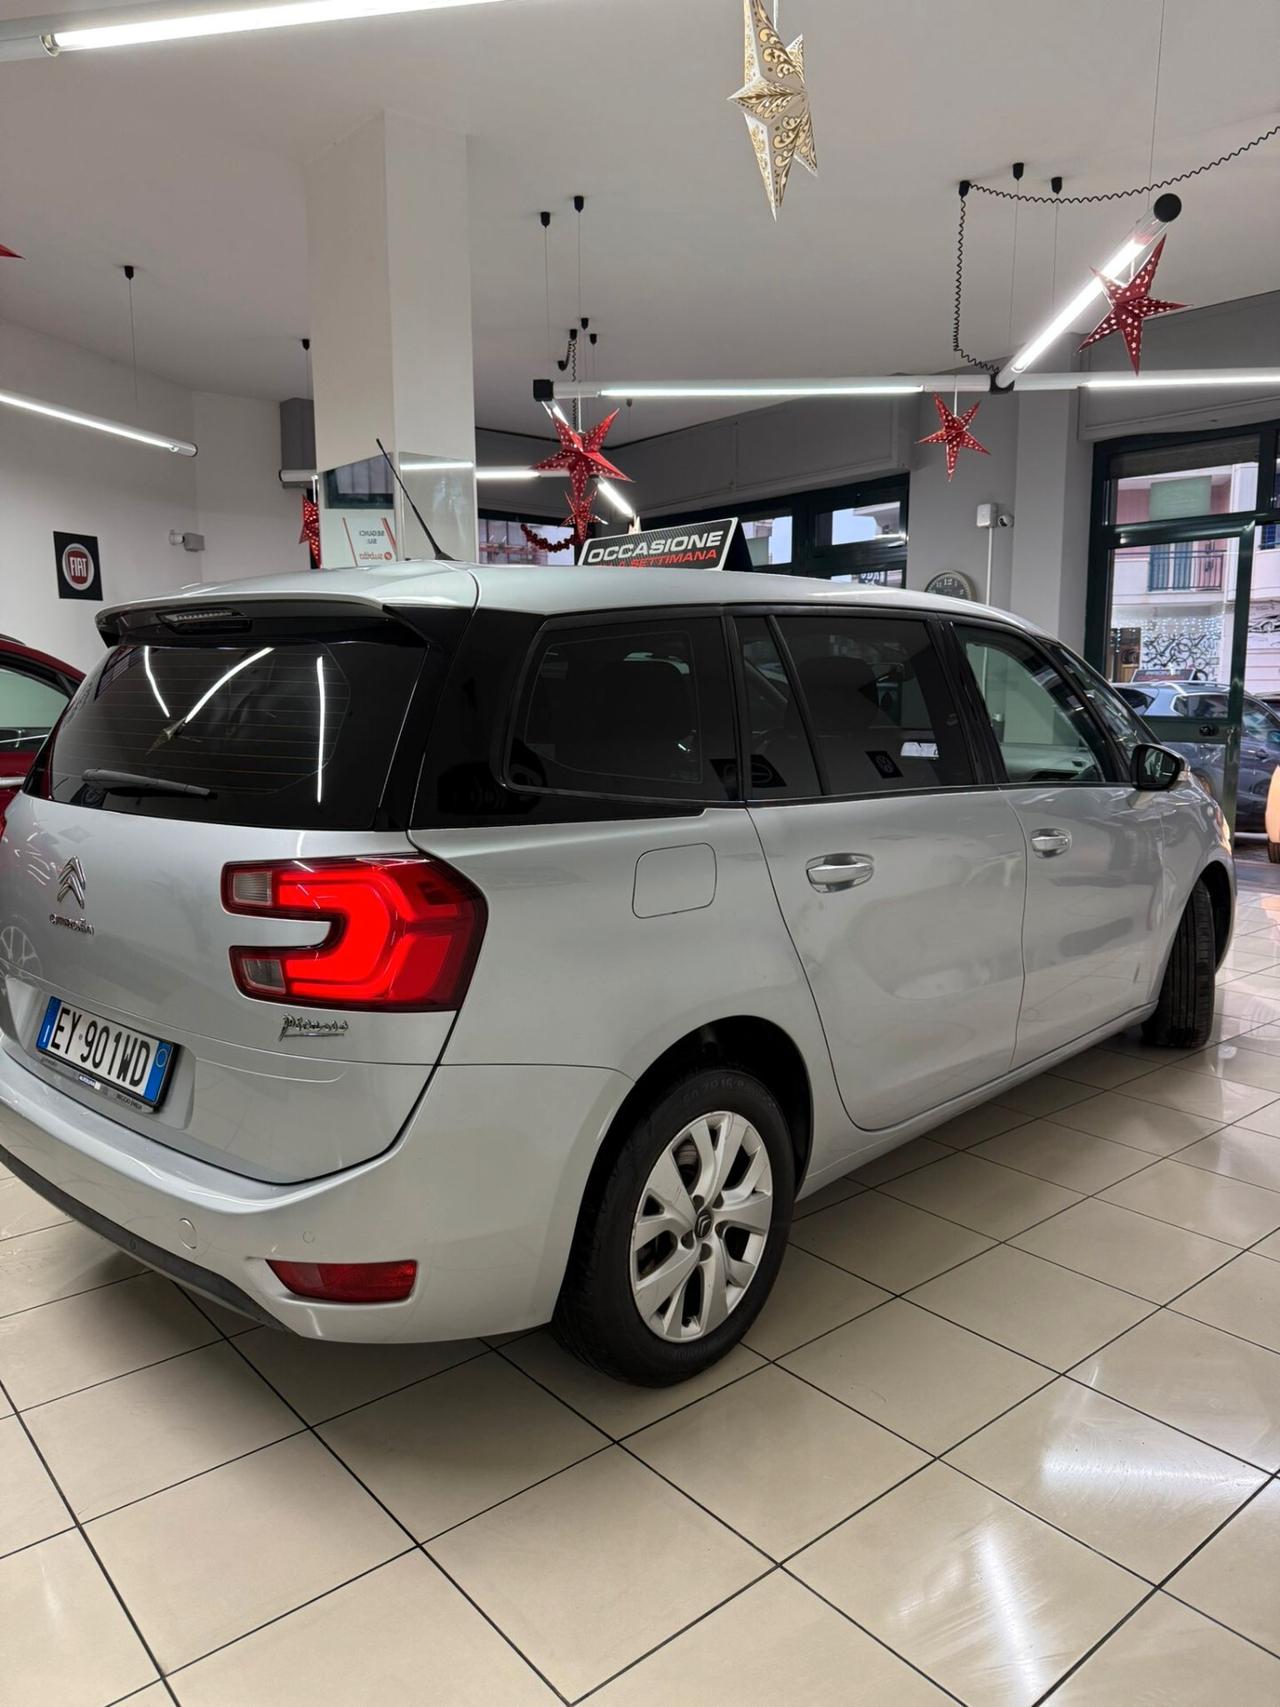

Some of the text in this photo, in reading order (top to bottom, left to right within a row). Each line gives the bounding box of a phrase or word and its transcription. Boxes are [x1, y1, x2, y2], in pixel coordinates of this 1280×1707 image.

[587, 530, 724, 563] OCCASIONE
[69, 556, 88, 577] FIAT
[631, 549, 717, 568] SETTIMANA
